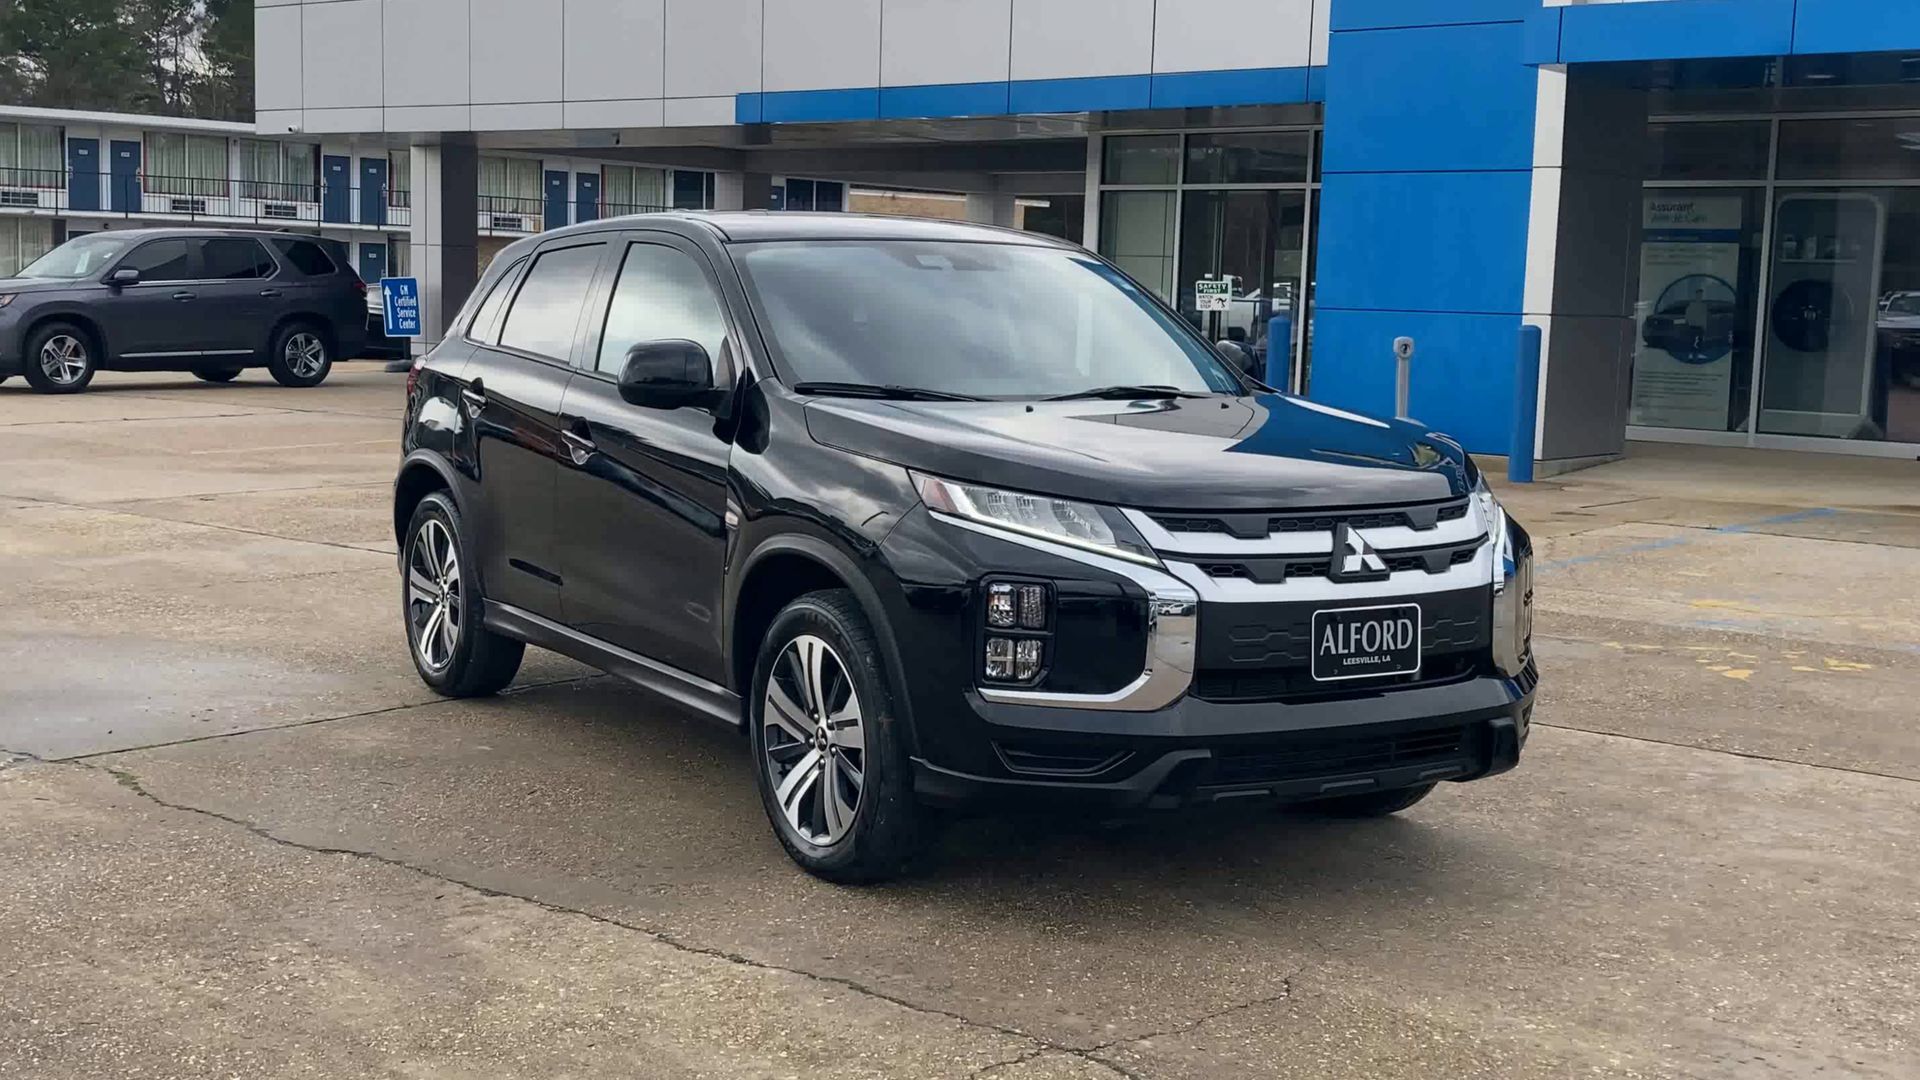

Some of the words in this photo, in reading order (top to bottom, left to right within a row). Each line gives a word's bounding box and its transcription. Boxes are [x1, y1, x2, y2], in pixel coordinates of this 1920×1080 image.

[394, 296, 417, 307] Certified
[397, 307, 416, 318] Service
[399, 318, 416, 329] Center
[1320, 619, 1413, 656] ALFORD
[1343, 656, 1381, 665] LEESVILLE,
